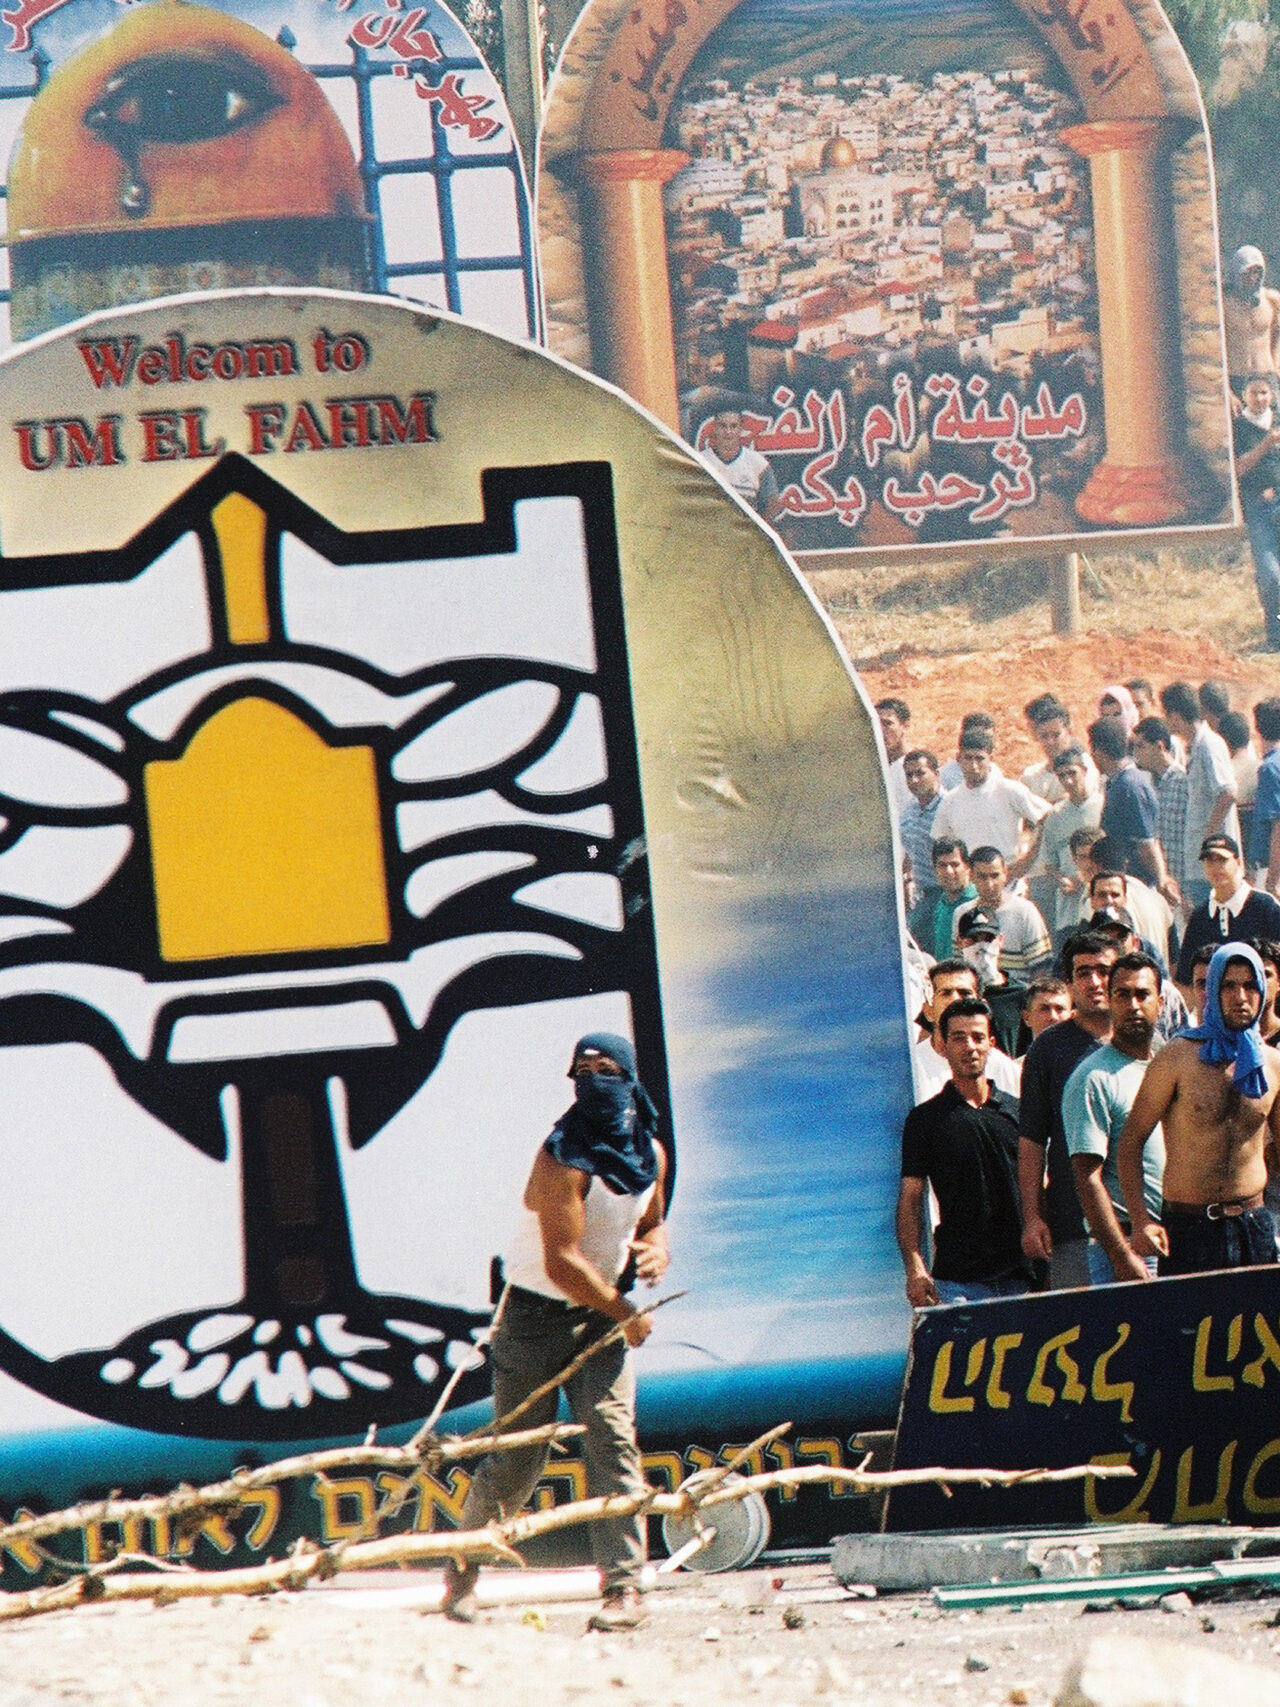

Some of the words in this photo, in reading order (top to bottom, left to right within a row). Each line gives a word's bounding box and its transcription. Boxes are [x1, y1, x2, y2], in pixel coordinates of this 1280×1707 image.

[77, 331, 299, 388] Welcom
[311, 328, 371, 374] to
[13, 416, 124, 471] UM
[138, 407, 224, 463] EL
[244, 391, 440, 455] FAHM
[863, 371, 914, 469] أم
[929, 372, 1087, 446] مدينة
[775, 451, 866, 527] بكم
[884, 444, 1039, 526] ترحب
[929, 1321, 1134, 1423] הנעל
